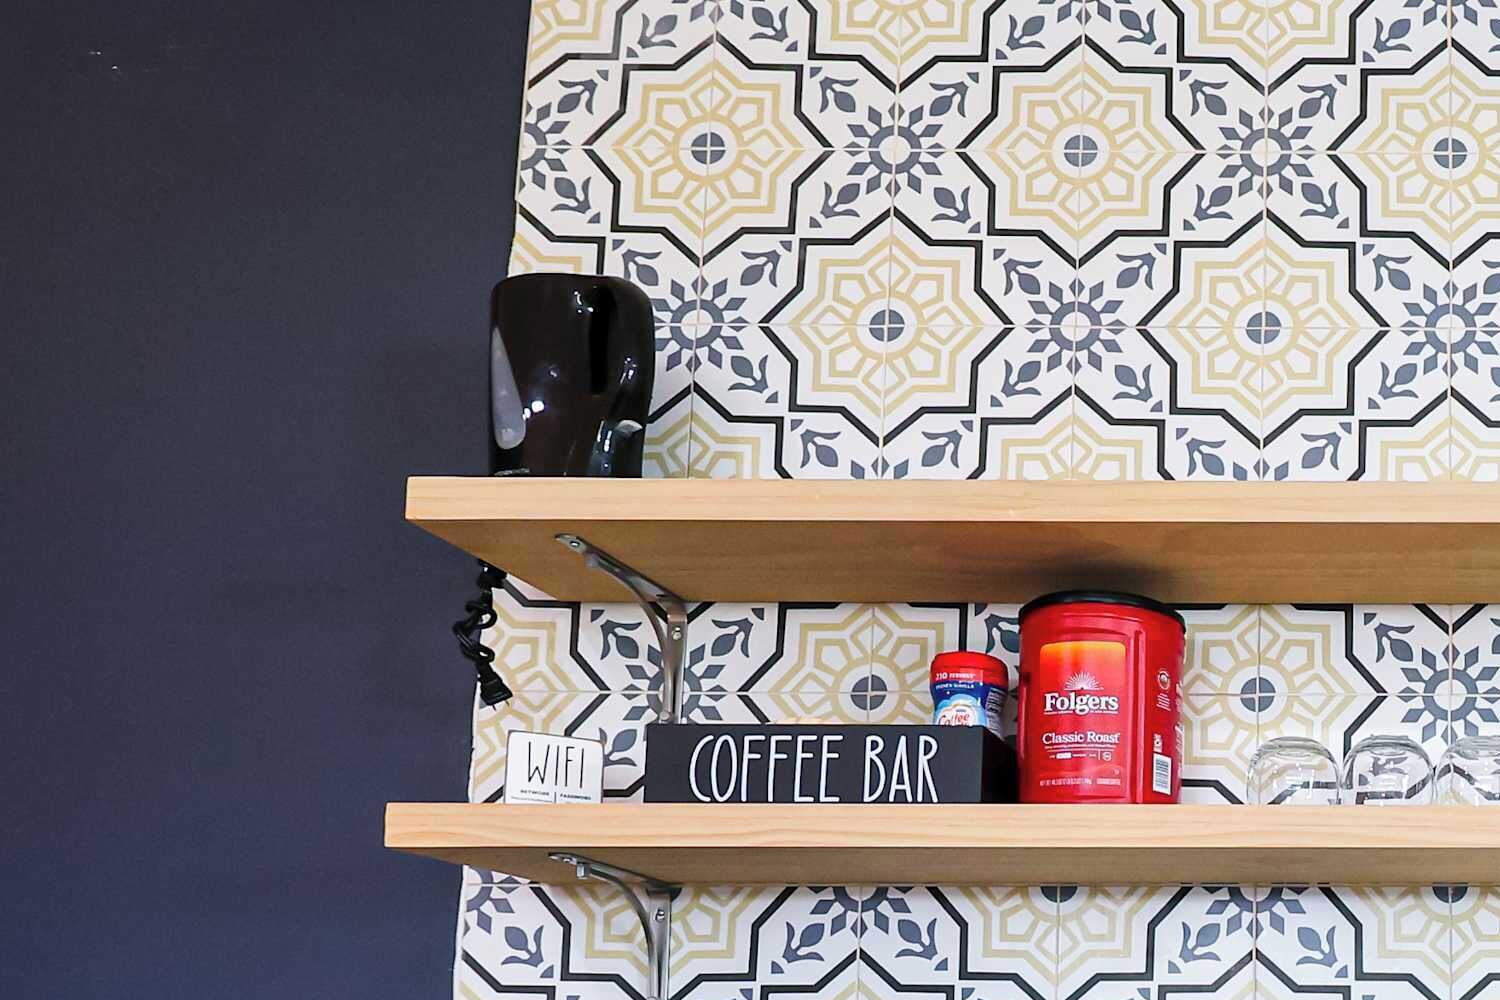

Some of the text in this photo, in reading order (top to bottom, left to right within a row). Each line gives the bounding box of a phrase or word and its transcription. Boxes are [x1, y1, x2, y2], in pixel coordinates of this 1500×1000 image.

[1044, 692, 1119, 715] Folgers
[1042, 731, 1120, 744] Classic Roast
[528, 741, 584, 789] WIFI
[690, 734, 938, 803] COFFEE BAR
